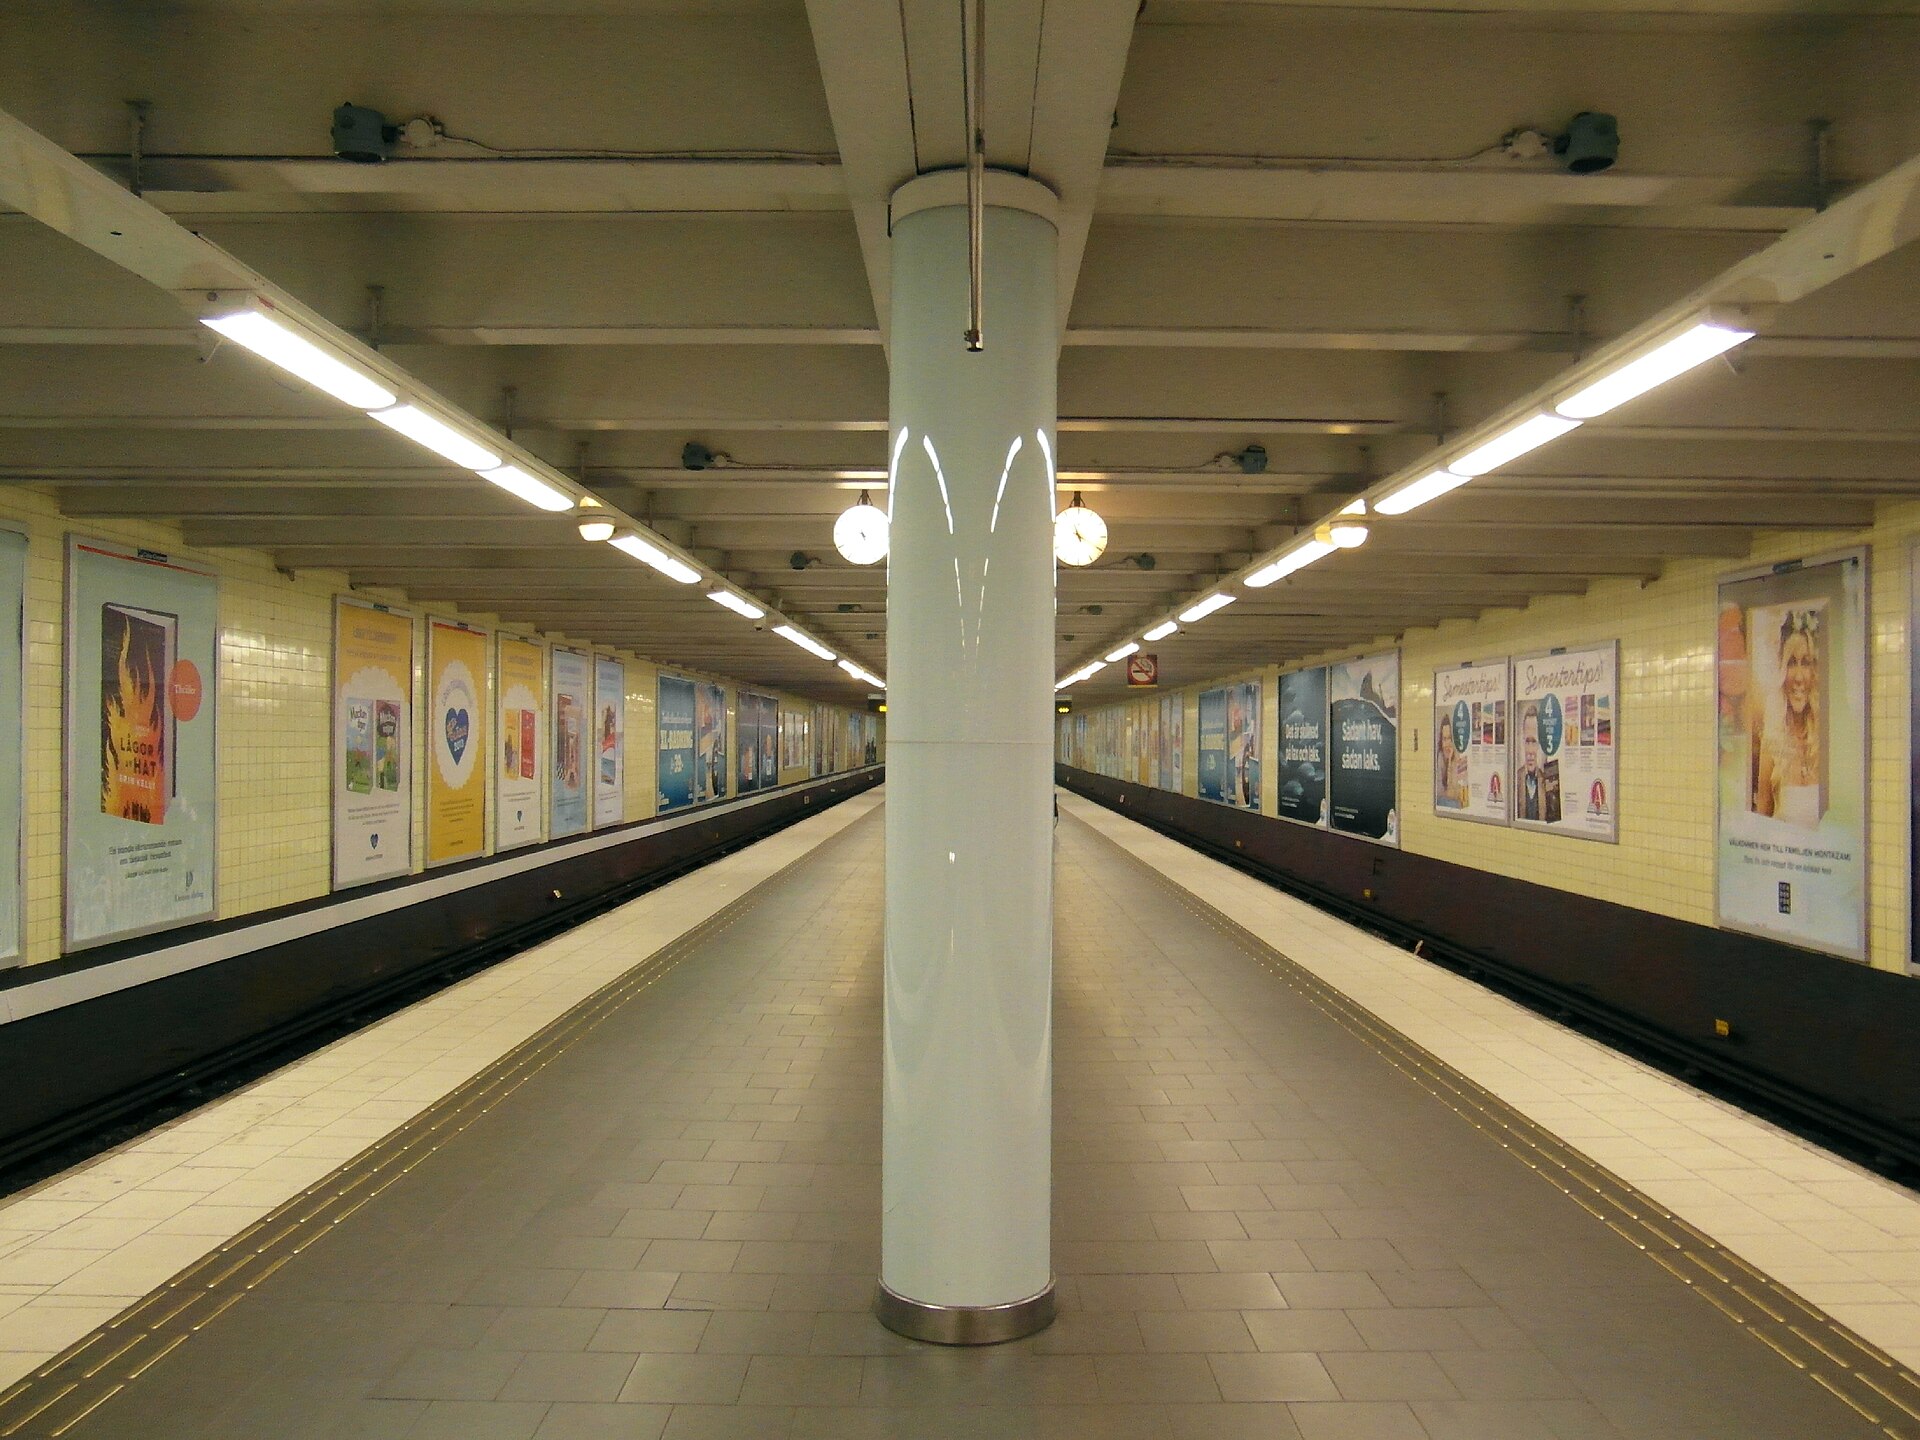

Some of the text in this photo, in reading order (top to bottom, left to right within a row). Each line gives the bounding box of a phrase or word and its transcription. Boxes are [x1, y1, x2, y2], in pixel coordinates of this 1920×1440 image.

[1443, 672, 1501, 702] Semestertips!
[1525, 660, 1603, 695] Semestertips!
[174, 684, 196, 695] Thriller
[1457, 703, 1464, 720] 4
[1545, 696, 1553, 717] 4
[120, 733, 155, 757] LÅGOR
[1458, 734, 1464, 750] 3
[1546, 734, 1553, 753] 3
[134, 756, 157, 778] HAT
[1342, 746, 1380, 771] sådan laks.
[1784, 845, 1813, 857] FAMILJEN
